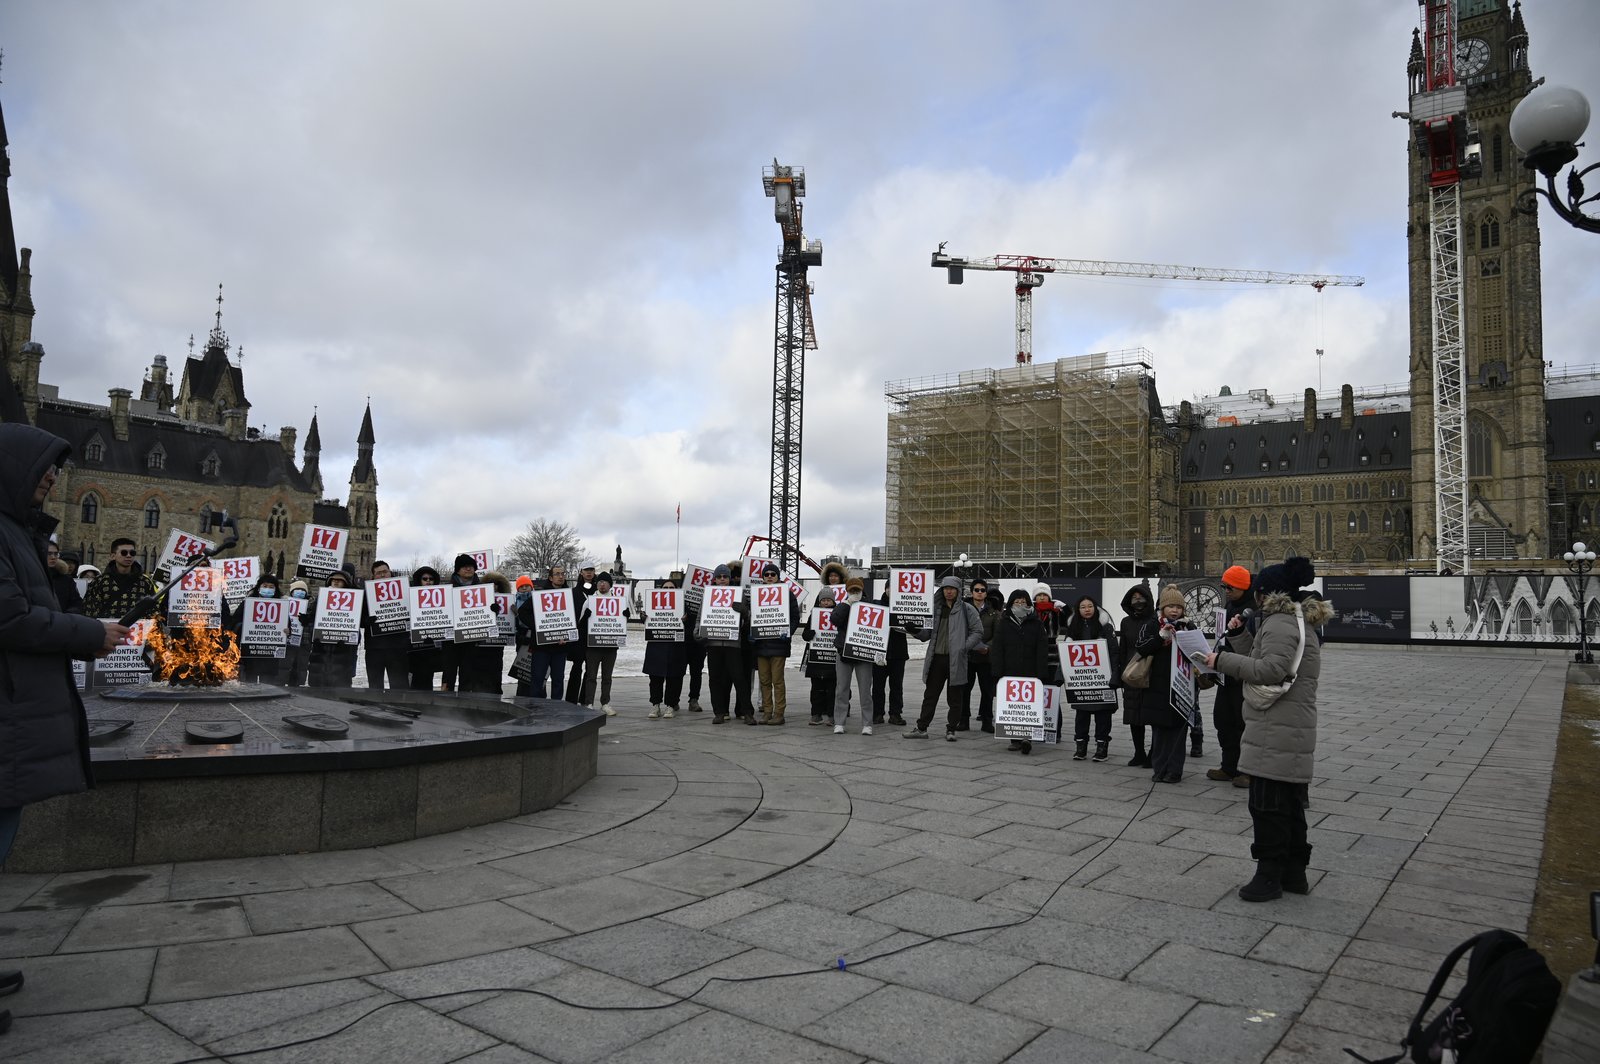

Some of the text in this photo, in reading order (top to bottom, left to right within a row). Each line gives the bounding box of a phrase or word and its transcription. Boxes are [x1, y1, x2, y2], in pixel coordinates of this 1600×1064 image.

[314, 530, 336, 549] 17
[226, 560, 248, 578] 35
[184, 570, 209, 591] 33
[378, 580, 400, 600] 30
[901, 572, 922, 593] 39
[330, 592, 352, 610] 32
[420, 588, 442, 608] 20
[464, 588, 484, 608] 31
[544, 592, 562, 612] 37
[655, 592, 672, 610] 11
[712, 588, 732, 607] 23
[760, 587, 780, 606] 22
[256, 602, 278, 622] 90
[598, 598, 618, 616] 40
[860, 606, 881, 627] 37
[859, 627, 878, 635] MONTHS
[1072, 644, 1096, 666] 25
[1008, 680, 1032, 702] 36
